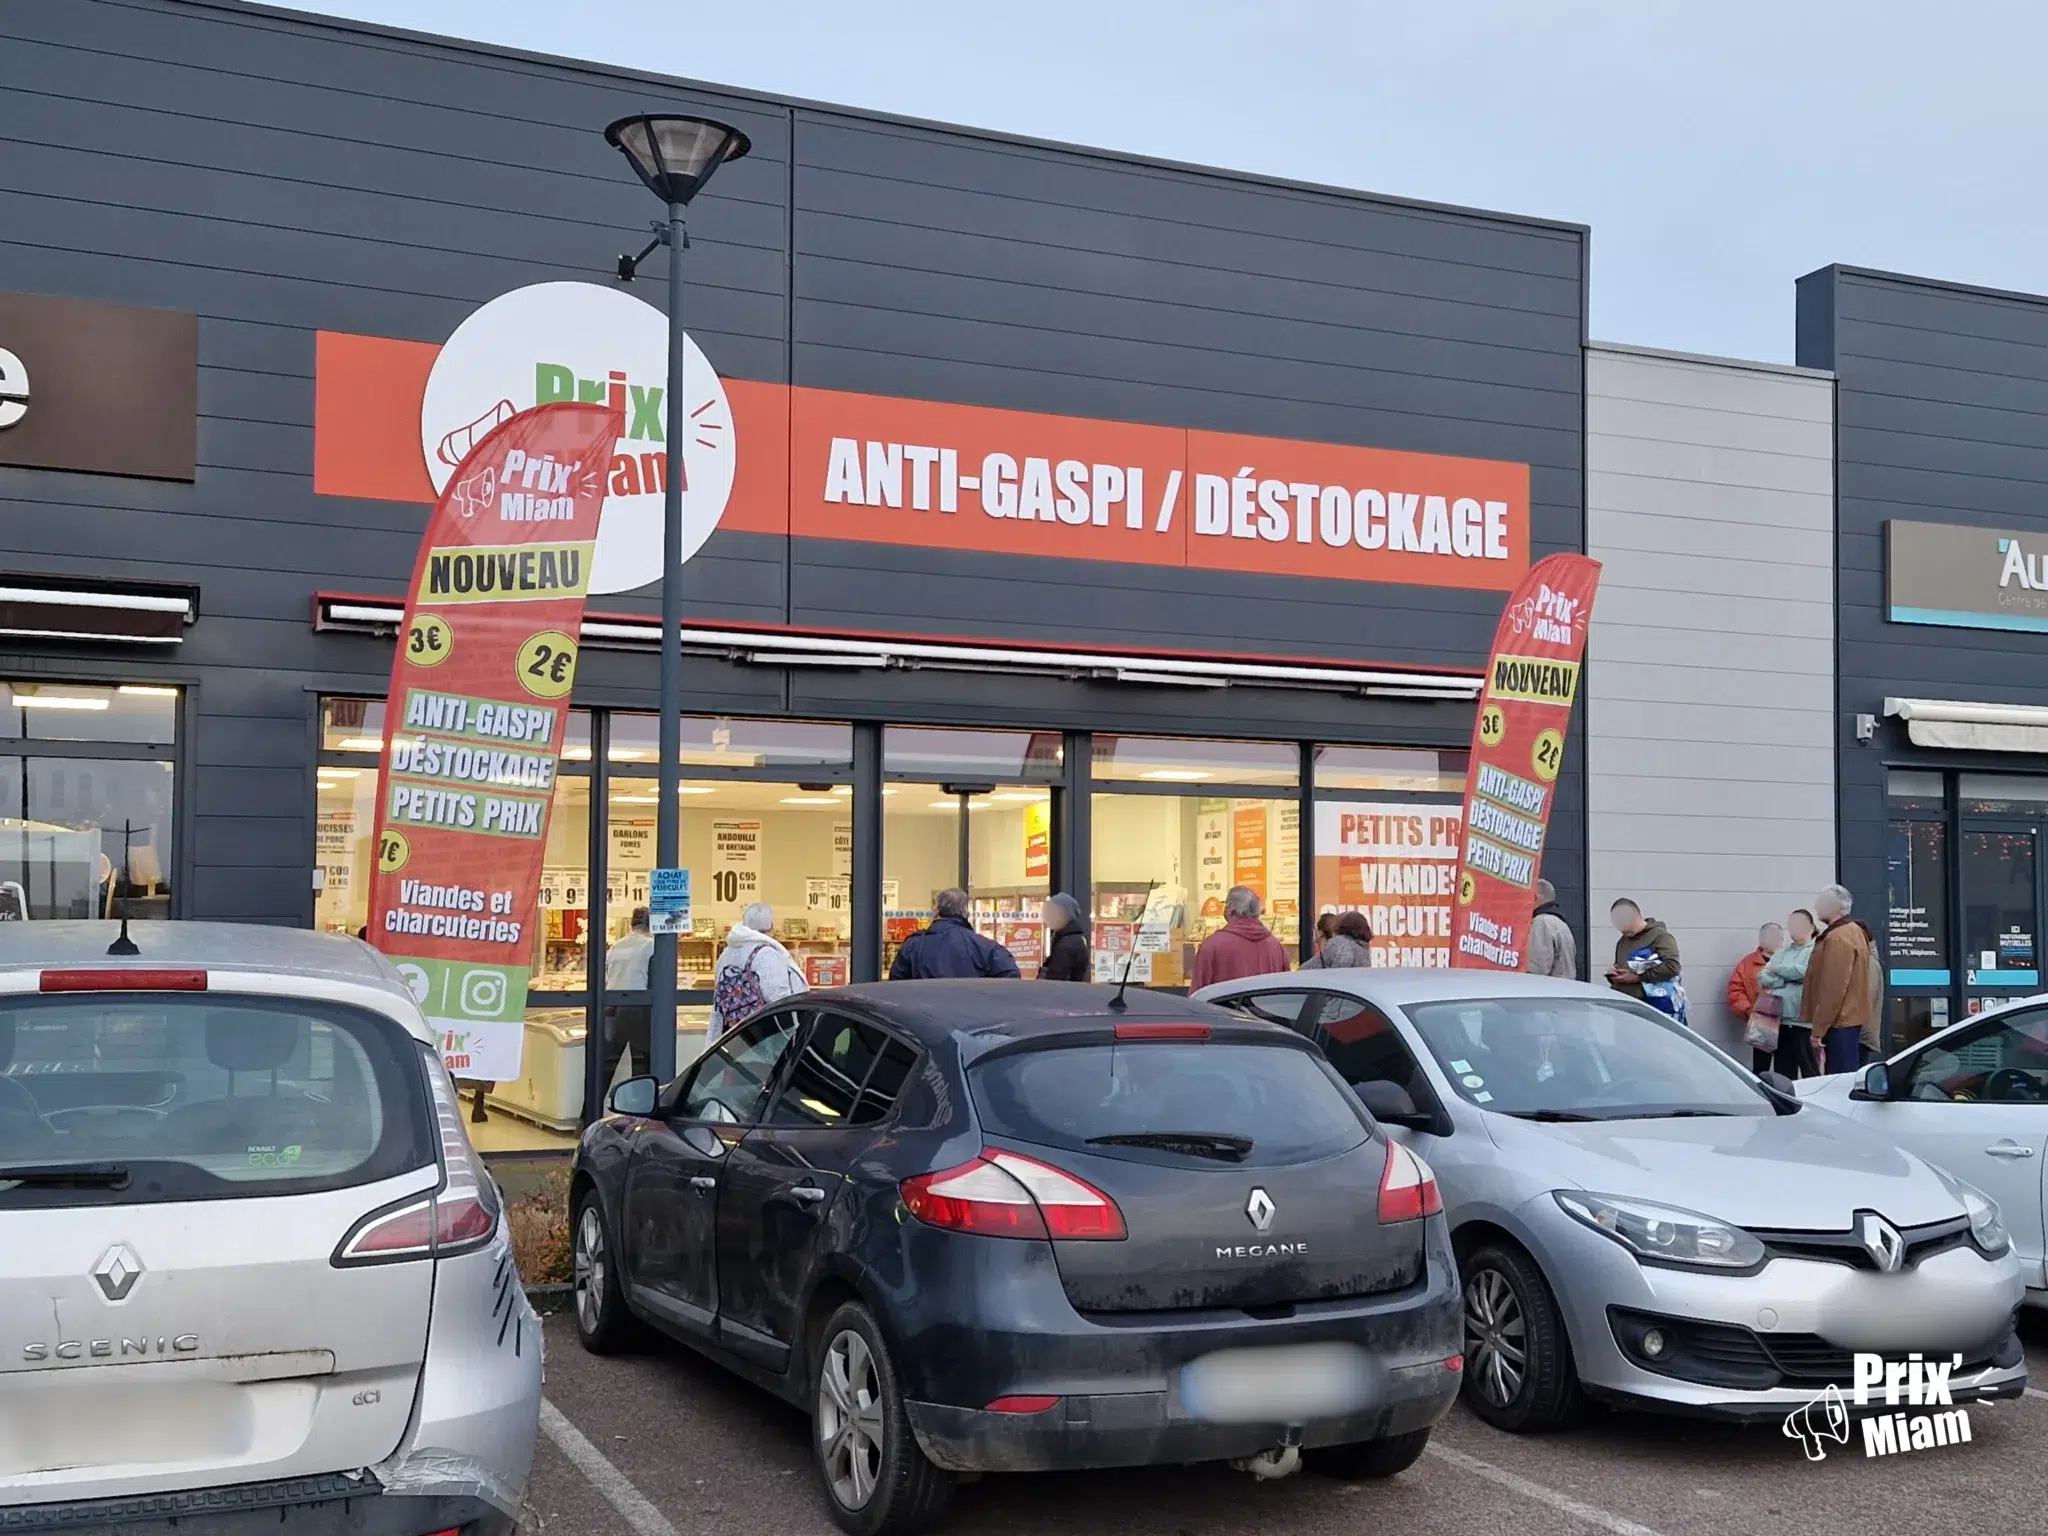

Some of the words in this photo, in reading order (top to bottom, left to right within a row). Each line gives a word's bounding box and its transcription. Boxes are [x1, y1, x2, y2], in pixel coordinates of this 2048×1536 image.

[500, 492, 574, 522] Miam
[824, 437, 1143, 529] ANTI-GASPI
[1154, 470, 1183, 533] /
[1195, 467, 1509, 560] DÉSTOCKAGE
[430, 550, 580, 594] NOUVEAU
[409, 626, 443, 654] 3€
[528, 645, 572, 683] 2€
[1495, 660, 1573, 698] NOUVEAU
[407, 694, 553, 743] ANTI-GASPI
[1482, 714, 1499, 735] 3€
[391, 737, 552, 790] DÉSTOCKAGE
[1537, 739, 1559, 770] 2€
[1478, 766, 1545, 815] ANTI-GASPI
[392, 785, 476, 827] PETITS
[482, 795, 541, 834] PRIX
[1469, 797, 1542, 852] DÉSTOCKAGE
[717, 833, 756, 842] ANDOUILLE
[1340, 813, 1424, 847] PETITS
[1430, 816, 1461, 847] PR
[1466, 837, 1500, 874] PETITS
[1501, 851, 1533, 885] PRIX
[400, 879, 484, 912] Viandes
[489, 891, 512, 915] et
[713, 870, 738, 902] 10
[385, 909, 521, 944] charcuteries
[1501, 924, 1513, 945] et
[1215, 1242, 1309, 1259] MEGANE
[23, 1333, 199, 1361] SCENIC
